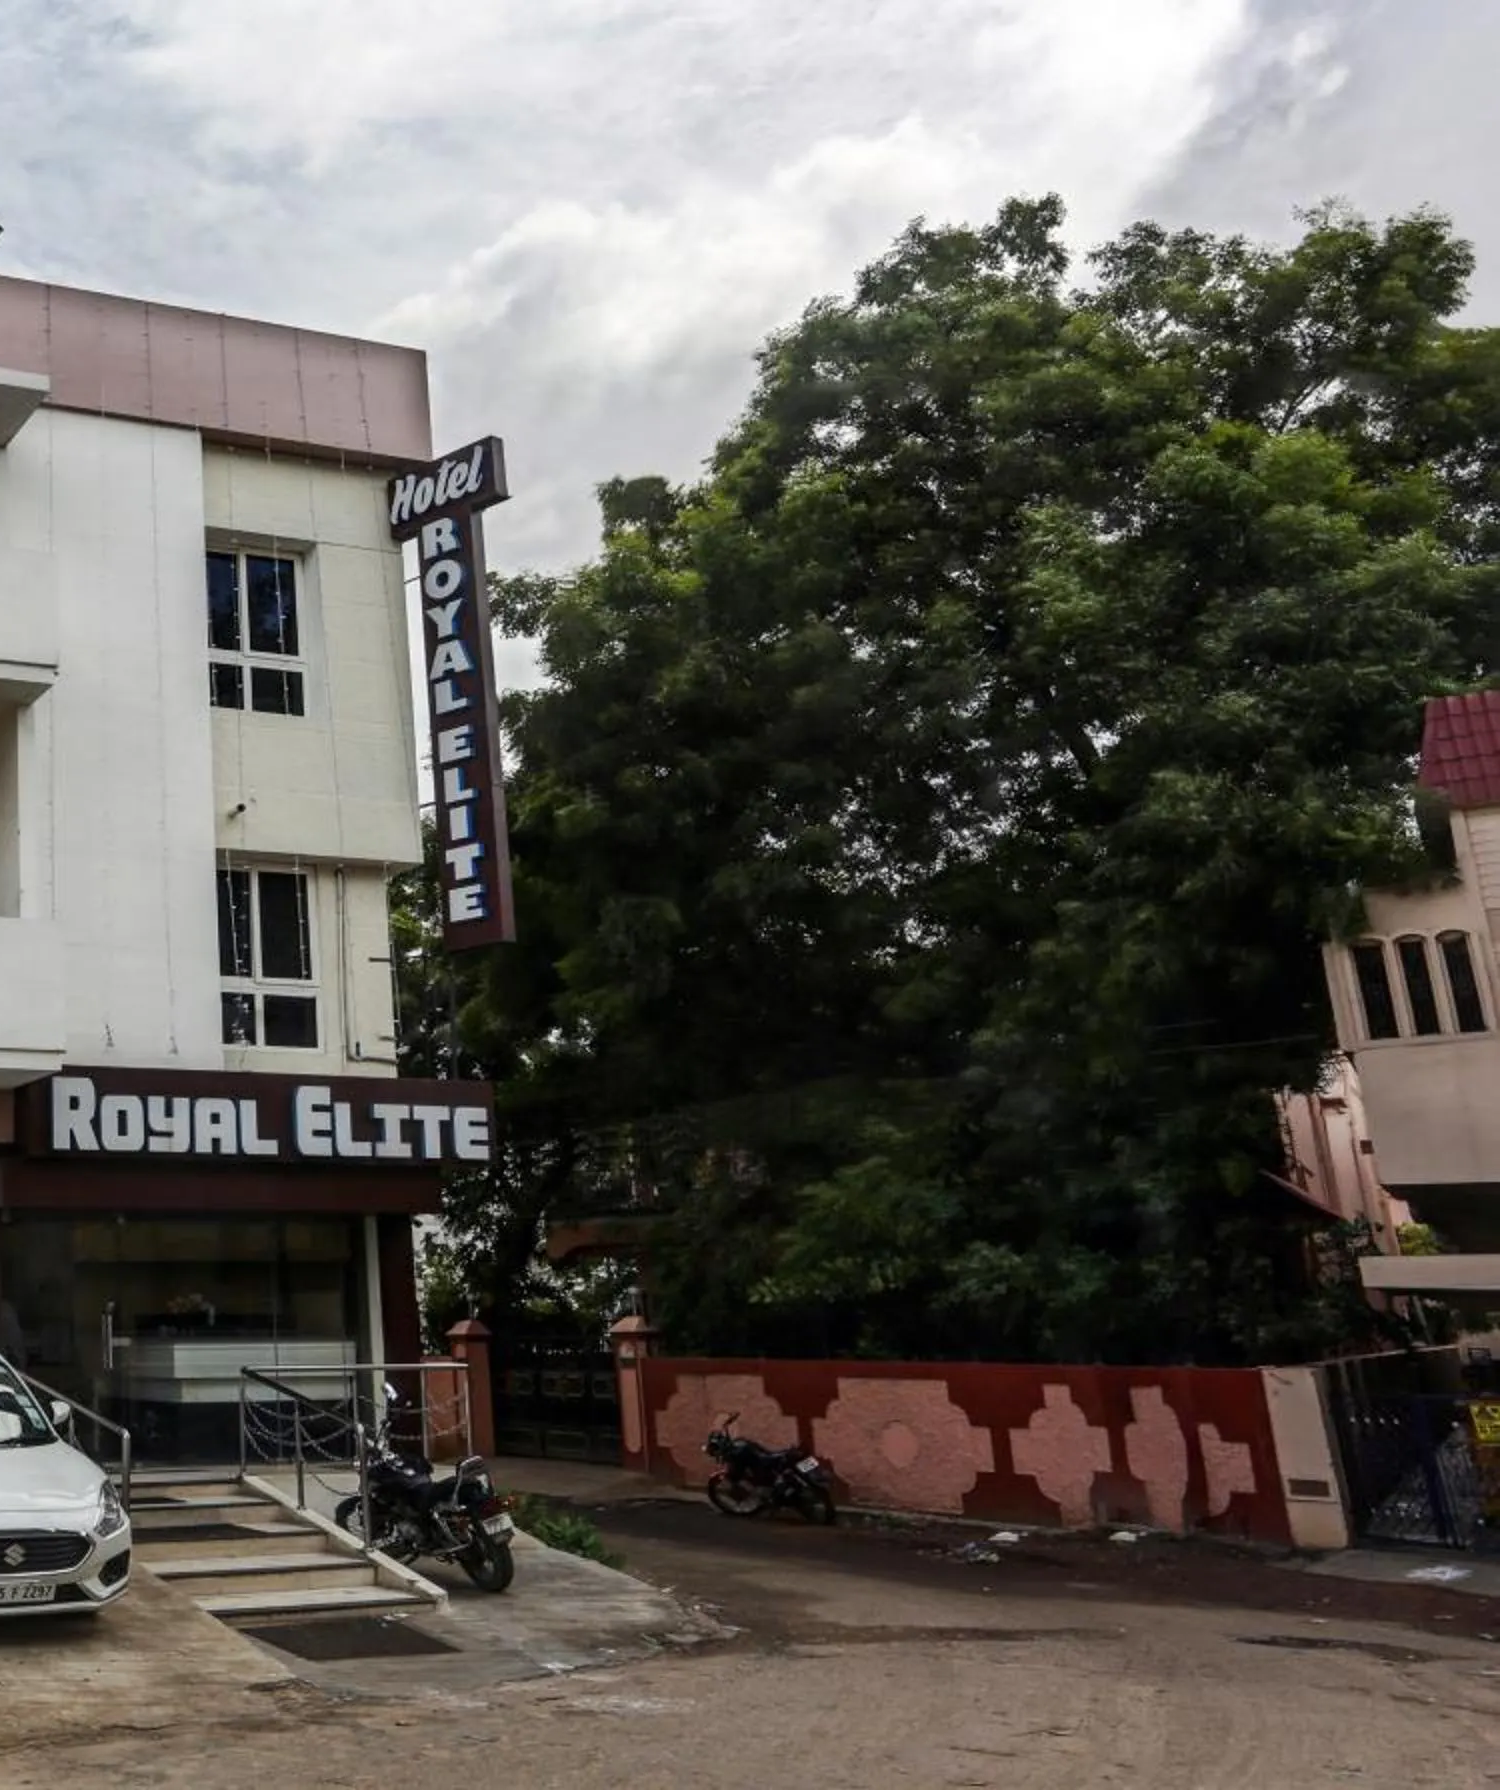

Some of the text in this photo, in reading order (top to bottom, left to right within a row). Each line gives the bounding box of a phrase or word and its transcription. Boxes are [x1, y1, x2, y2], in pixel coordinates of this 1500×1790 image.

[390, 446, 484, 525] Hotel
[421, 516, 486, 923] ROYAL ELITE
[51, 1075, 490, 1161] ROYAL ELITE
